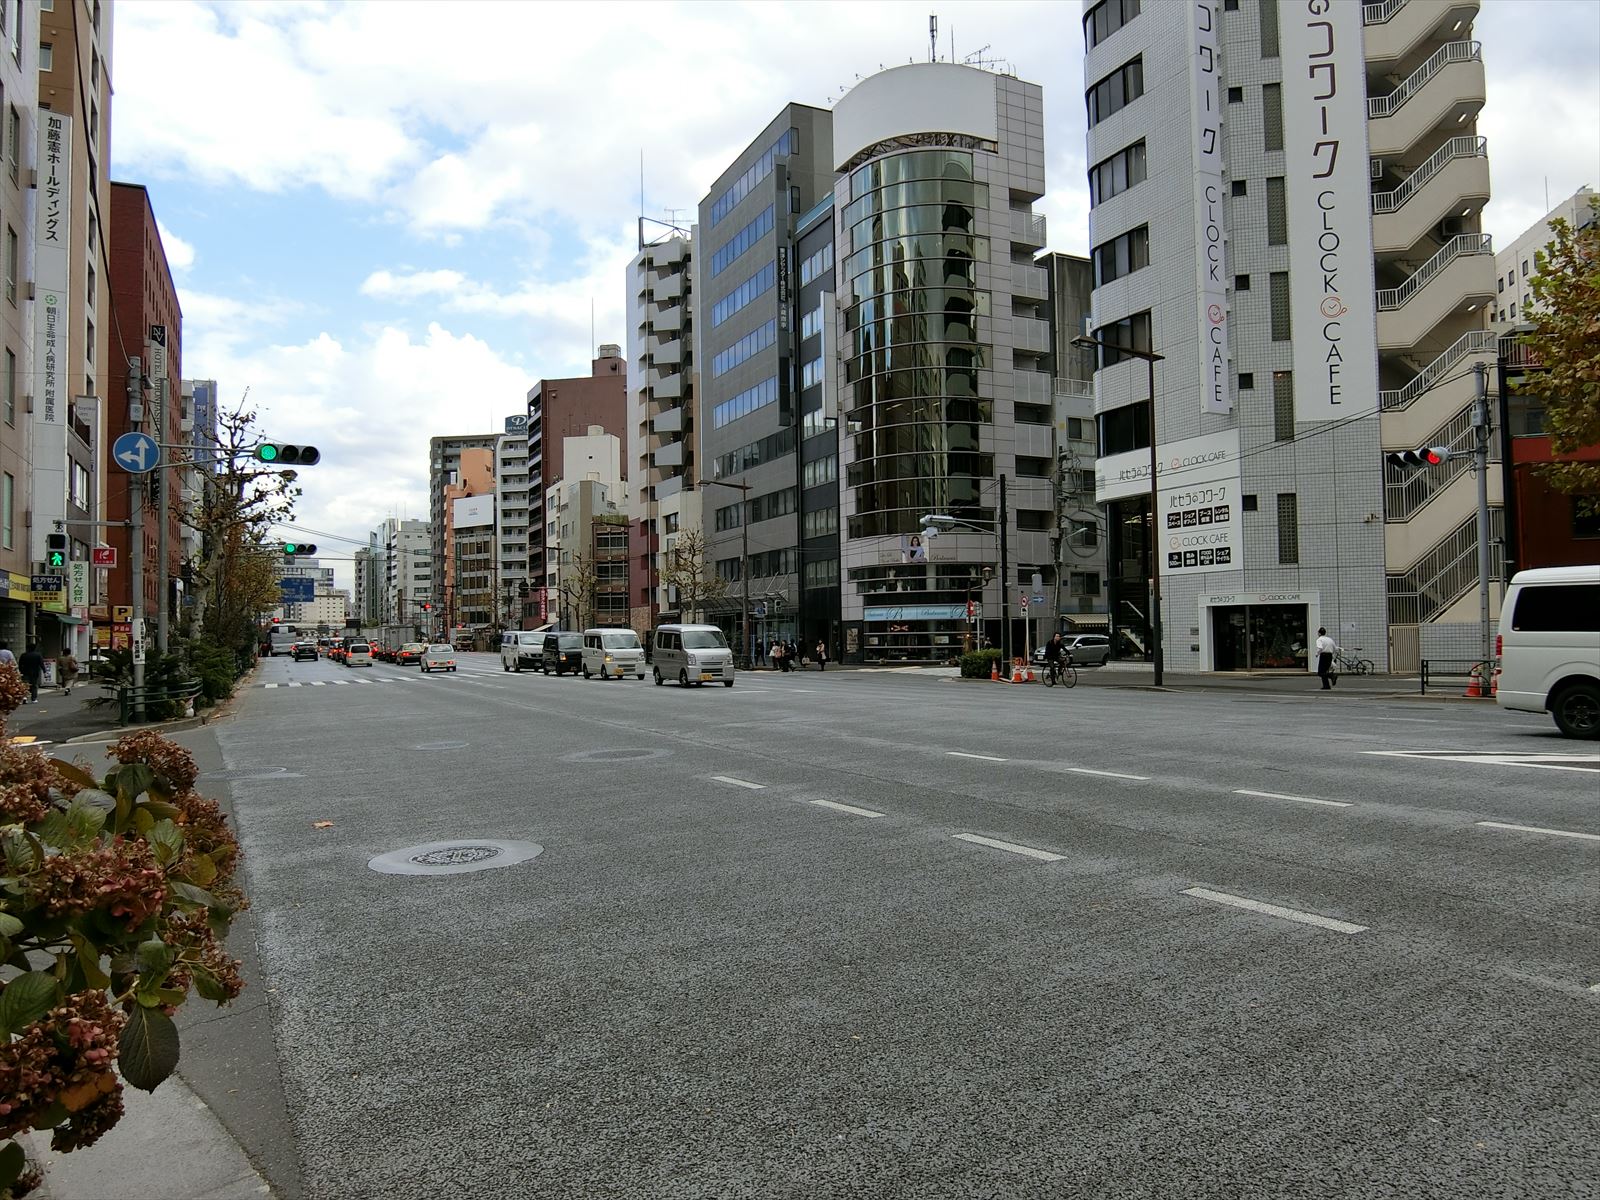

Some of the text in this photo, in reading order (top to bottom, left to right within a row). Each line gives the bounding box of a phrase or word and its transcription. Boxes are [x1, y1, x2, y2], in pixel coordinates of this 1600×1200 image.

[46, 116, 62, 242] 加藤憲ホールディングス
[1205, 185, 1220, 282] CLOCK
[1317, 190, 1340, 294] CLOCK
[154, 348, 162, 375] HOTEL
[1210, 326, 1223, 402] CAFE
[1323, 321, 1343, 405] CAFE
[1182, 454, 1207, 468] CLOCK
[1208, 450, 1226, 462] CAFE
[1182, 532, 1229, 547] CLOCK CAFE
[32, 576, 60, 584] 処方せん
[73, 563, 83, 603] 処方せん受付
[118, 607, 128, 616] P
